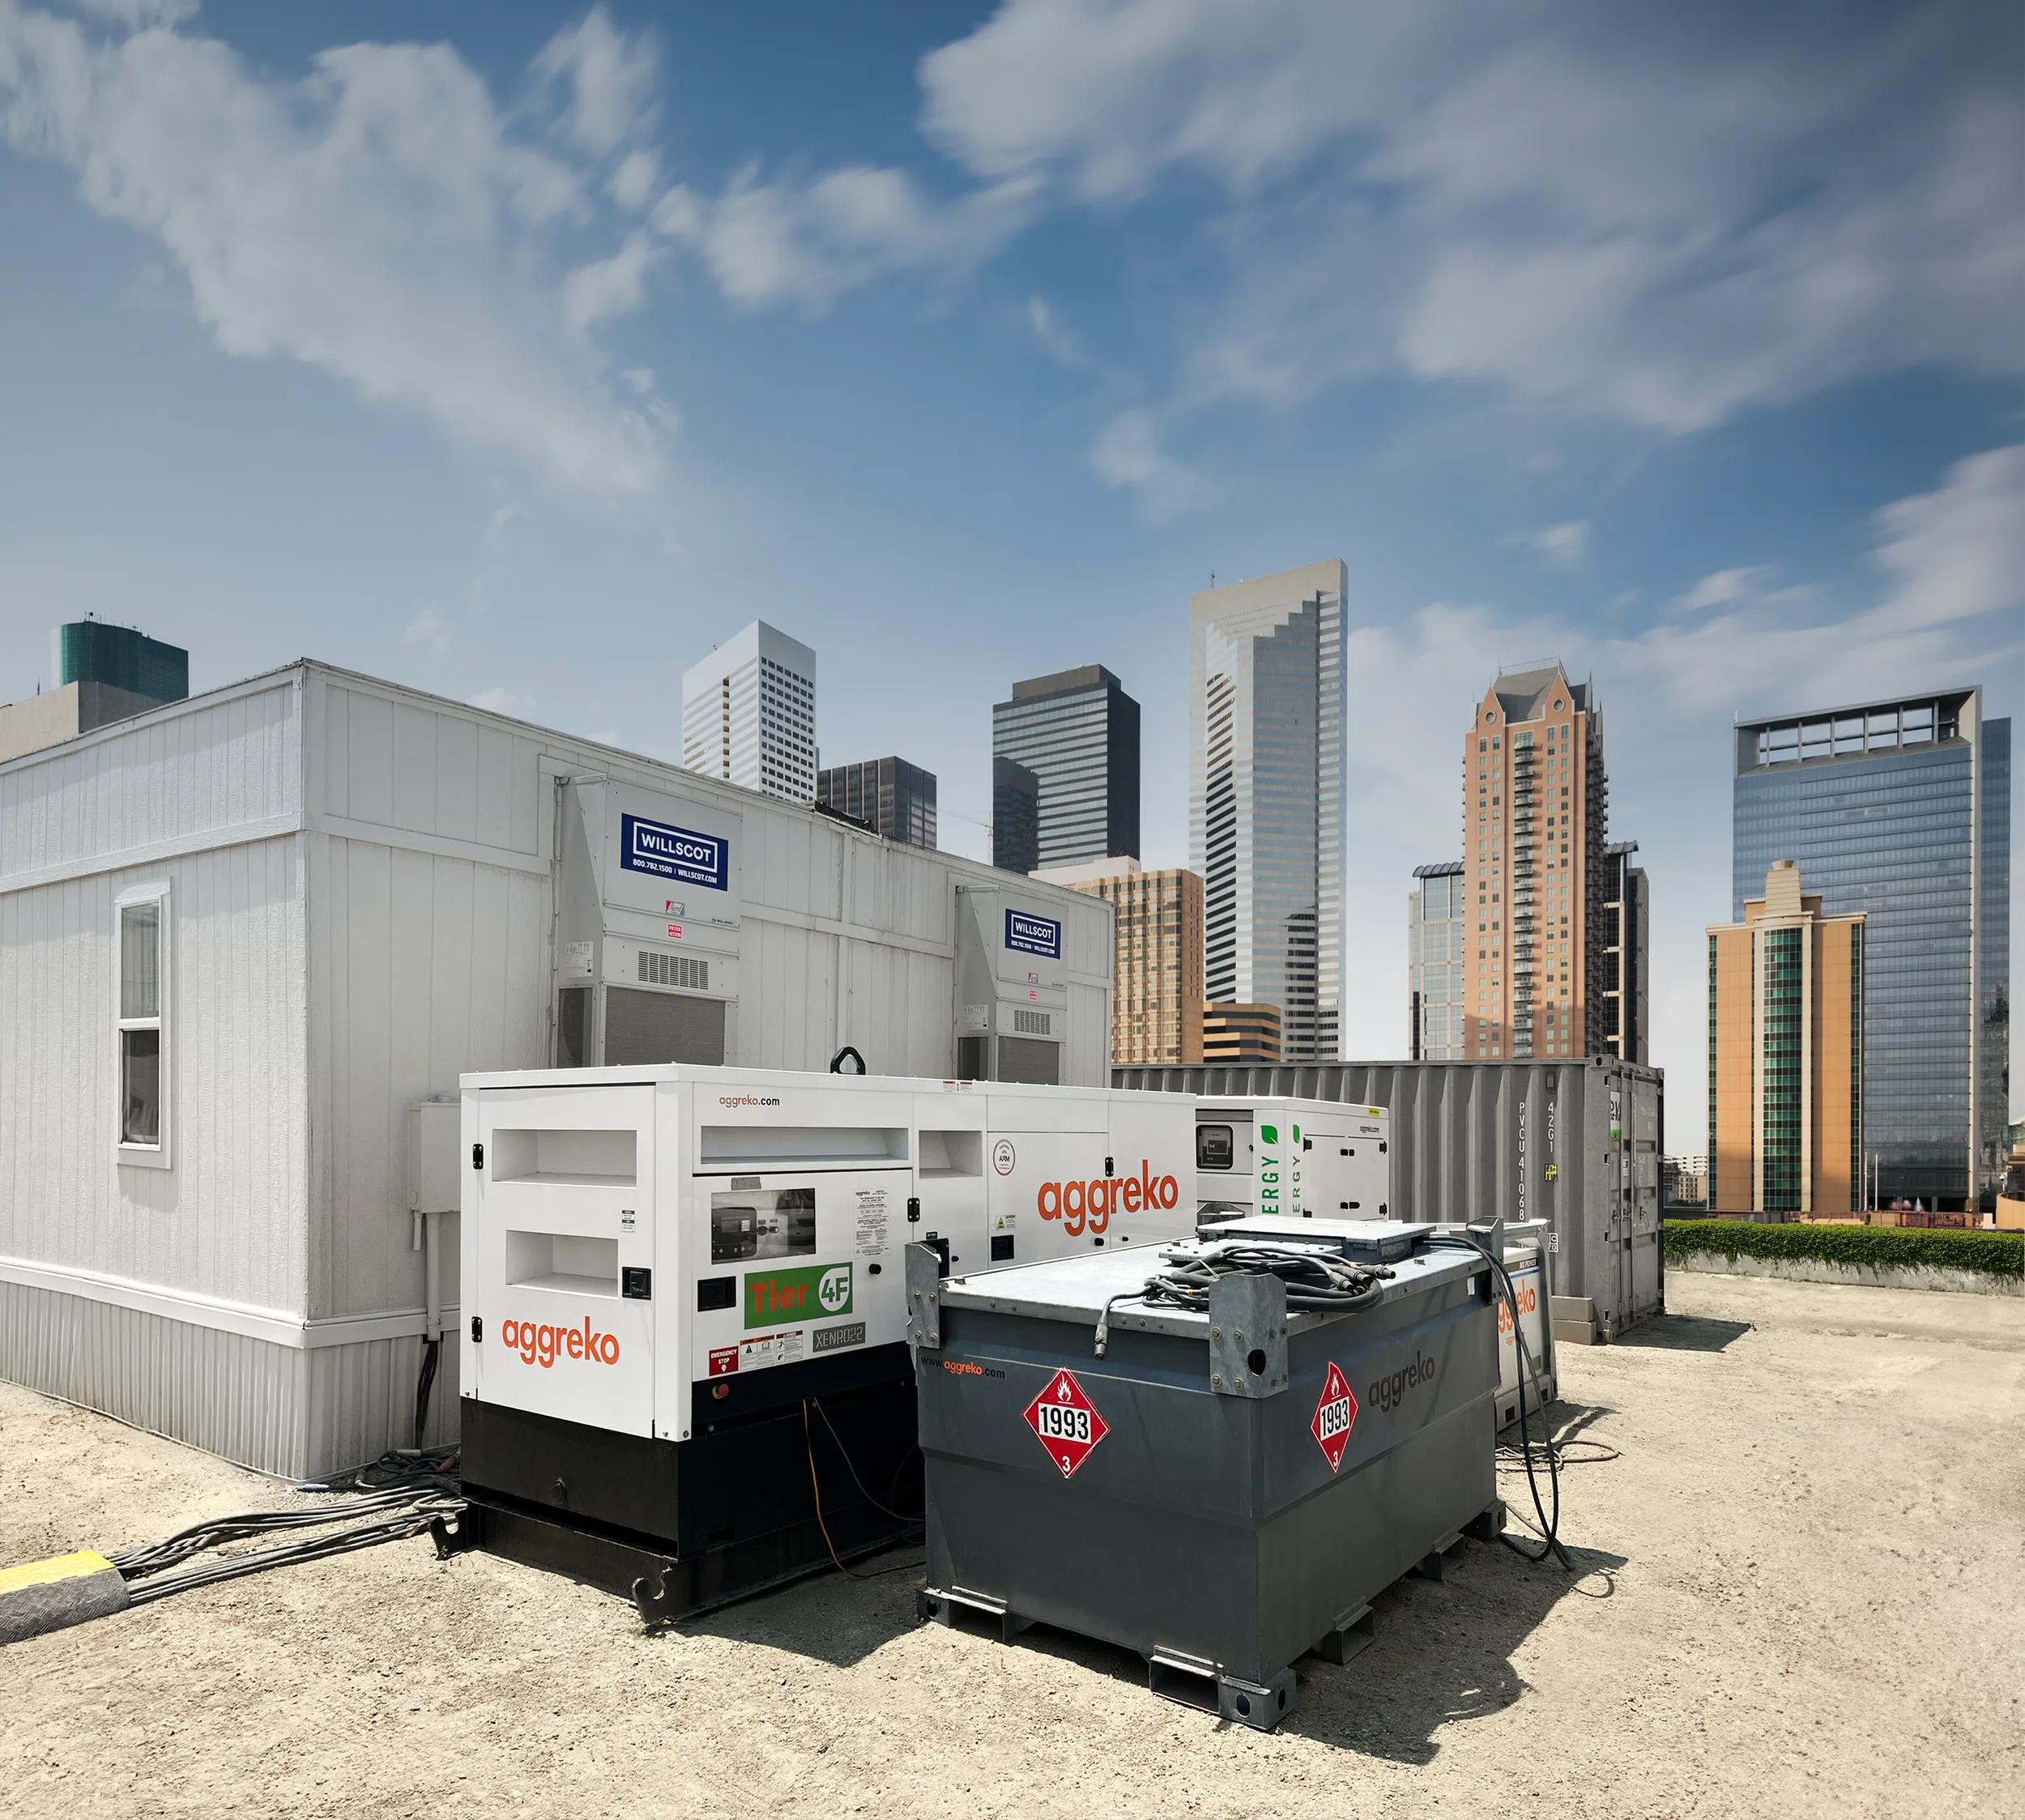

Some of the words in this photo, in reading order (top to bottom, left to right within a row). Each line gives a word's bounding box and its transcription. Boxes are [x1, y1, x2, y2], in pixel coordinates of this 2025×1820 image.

[641, 833, 712, 862] WILLSCOT
[633, 859, 672, 874] 800.782.1500
[678, 868, 718, 884] WILLSCOT.COM
[1015, 921, 1052, 940] WILLSCOT
[719, 1094, 780, 1108] aggreko.com
[1038, 1159, 1179, 1237] aggreko
[750, 1278, 808, 1313] Tier
[821, 1277, 848, 1302] 4F
[501, 1316, 620, 1369] aggreko
[710, 1349, 737, 1358] EMERGENCY
[921, 1357, 1005, 1379] www.aggreko.com
[1369, 1350, 1435, 1412] aggreko
[1040, 1405, 1089, 1440] 1993
[1321, 1399, 1349, 1436] 1993
[1061, 1456, 1071, 1473] 3
[1333, 1450, 1339, 1467] 3
